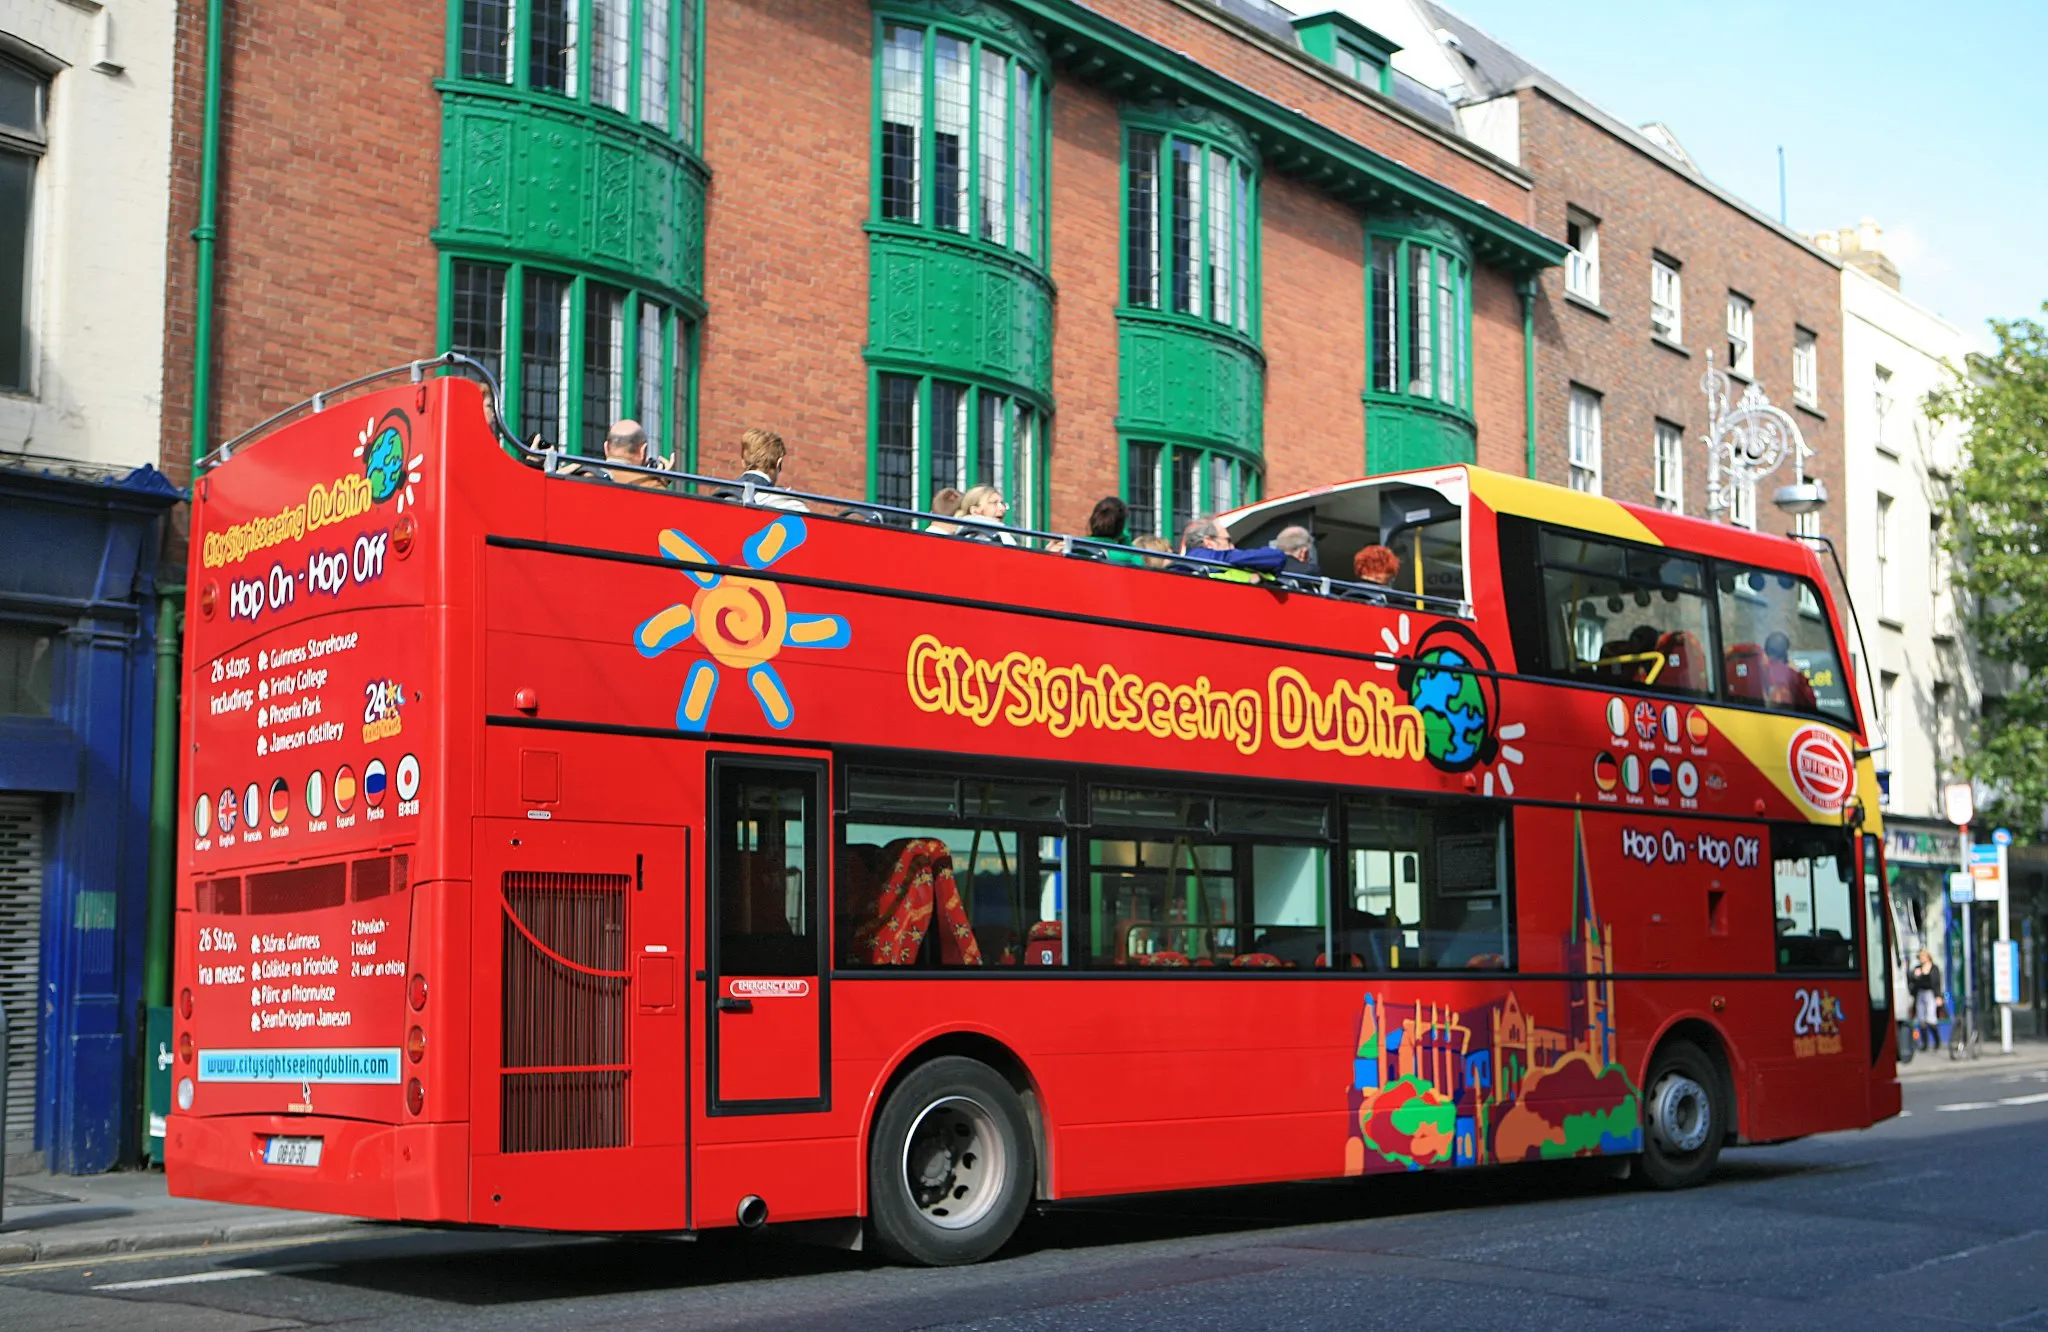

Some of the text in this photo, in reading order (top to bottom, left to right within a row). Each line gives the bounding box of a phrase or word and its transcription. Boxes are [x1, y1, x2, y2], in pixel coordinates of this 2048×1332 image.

[307, 473, 372, 531] Dublin
[230, 533, 388, 620] Hop On Hop Off
[270, 631, 358, 669] Guinness Storehouse
[211, 656, 251, 684] 26 stops
[270, 667, 328, 697] Trinity College
[210, 688, 254, 716] including:
[269, 695, 322, 725] Phoenix Park
[364, 681, 387, 724] 24
[907, 633, 1426, 761] CitySightseeing Dublin
[269, 732, 306, 753] Jameson
[306, 721, 345, 745] distillery
[1623, 828, 1760, 869] Hop On Hop Off
[199, 928, 212, 952] 26
[286, 931, 320, 951] Guinness
[351, 919, 357, 936] 2
[291, 961, 302, 978] na
[351, 960, 360, 978] 24
[280, 988, 292, 1004] an
[738, 980, 801, 991] EMERGENCY EXIT
[316, 1006, 351, 1027] Jameson
[1794, 988, 1823, 1035] 24
[206, 1054, 390, 1080] www.citysightseeingdublin.com
